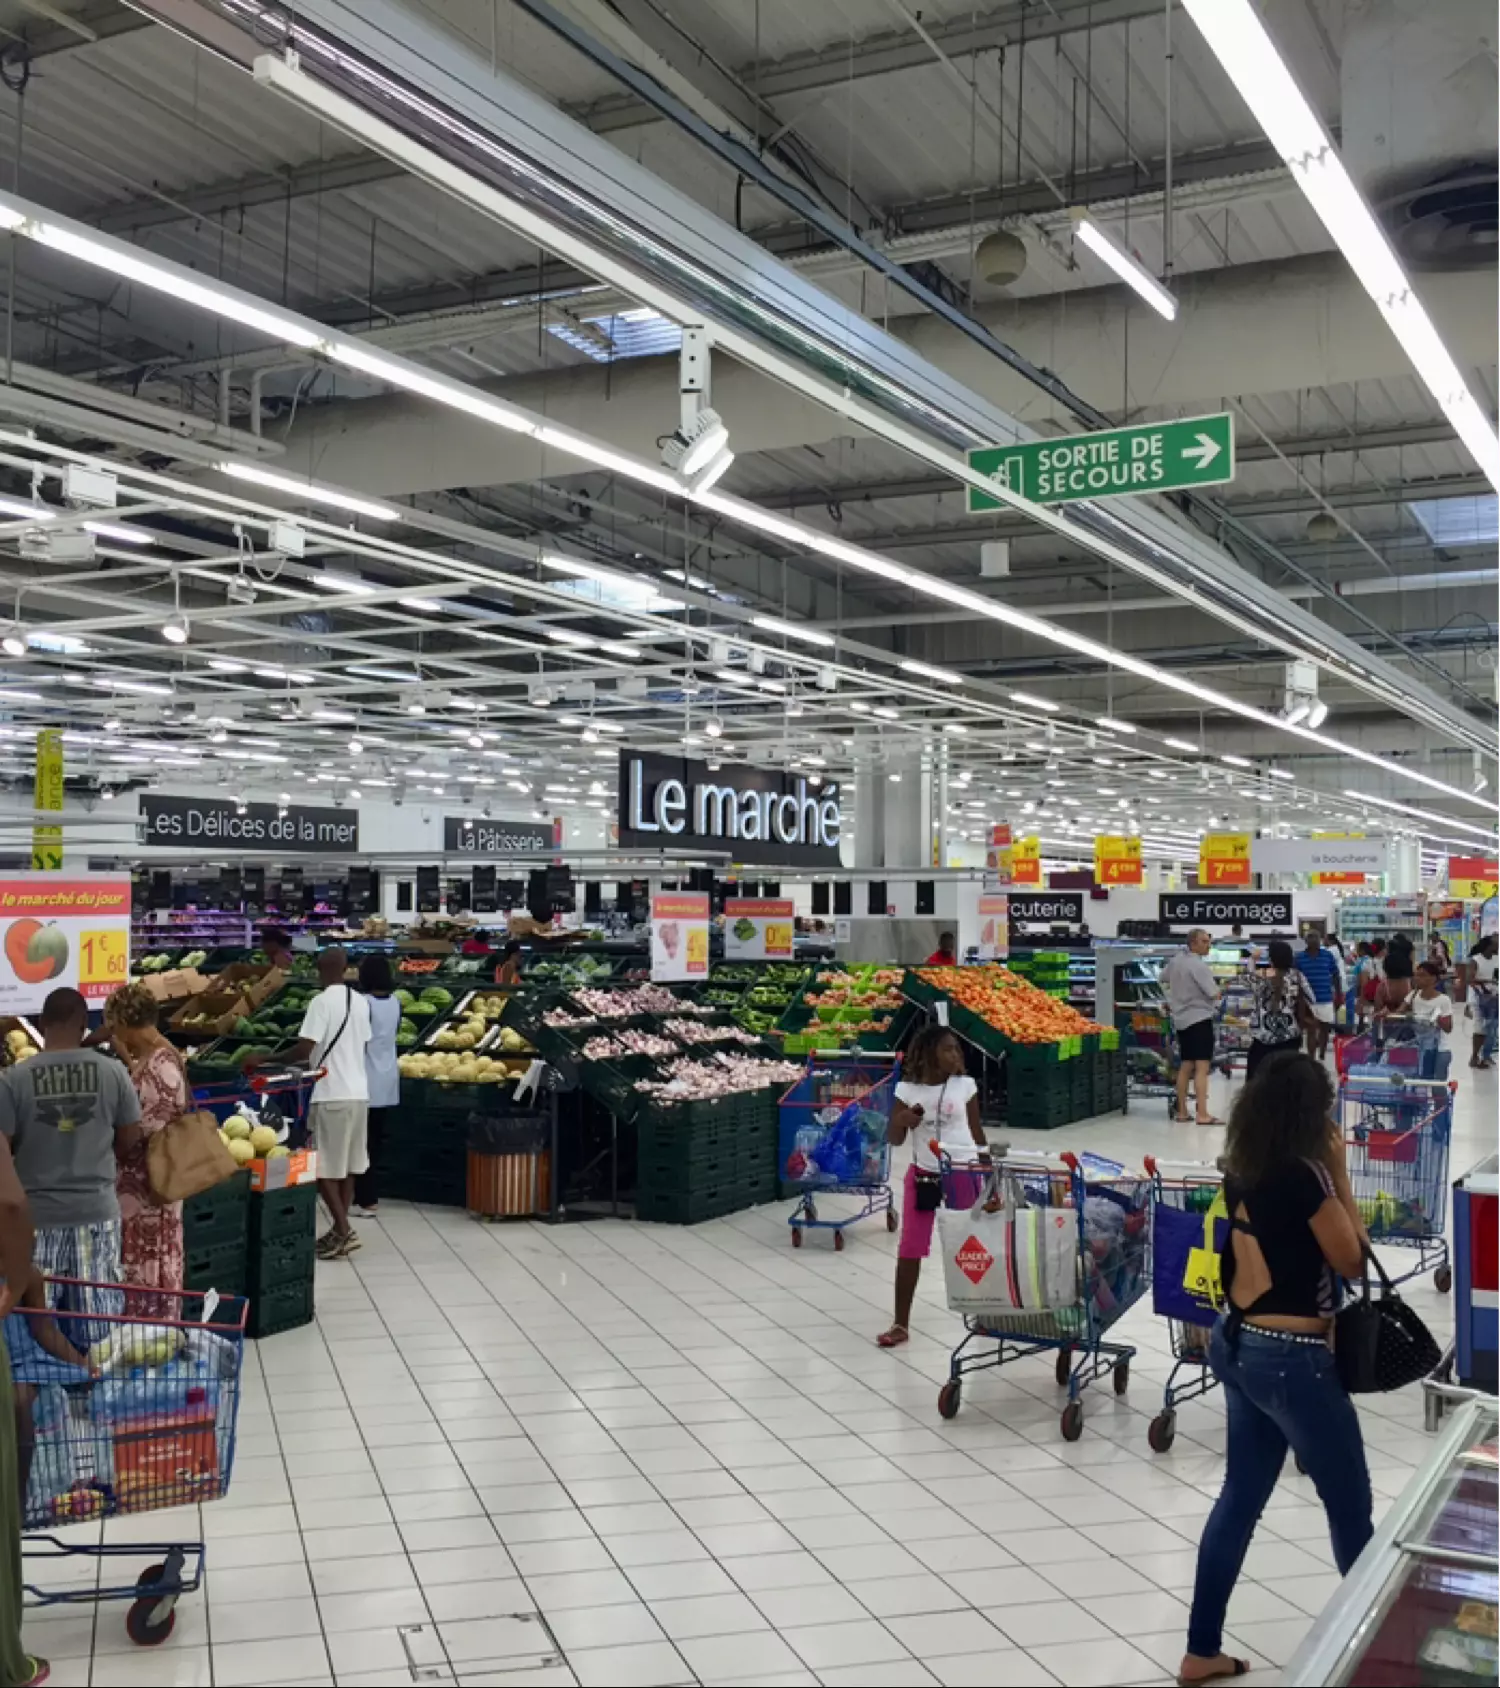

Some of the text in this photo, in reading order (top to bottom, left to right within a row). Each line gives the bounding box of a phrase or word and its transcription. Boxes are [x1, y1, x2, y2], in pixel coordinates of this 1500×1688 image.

[1038, 434, 1163, 471] SORTIE DE
[1038, 459, 1164, 495] SECOURS
[629, 759, 841, 847] Le marché
[144, 806, 355, 842] Les Délices de la mer
[457, 827, 544, 850] La Pâtisserie
[1311, 854, 1378, 863] la boucherie
[2, 891, 124, 908] le marché du jour
[1165, 901, 1286, 923] Le Fromage
[82, 936, 94, 975] 1
[961, 1261, 987, 1272] PRICE
